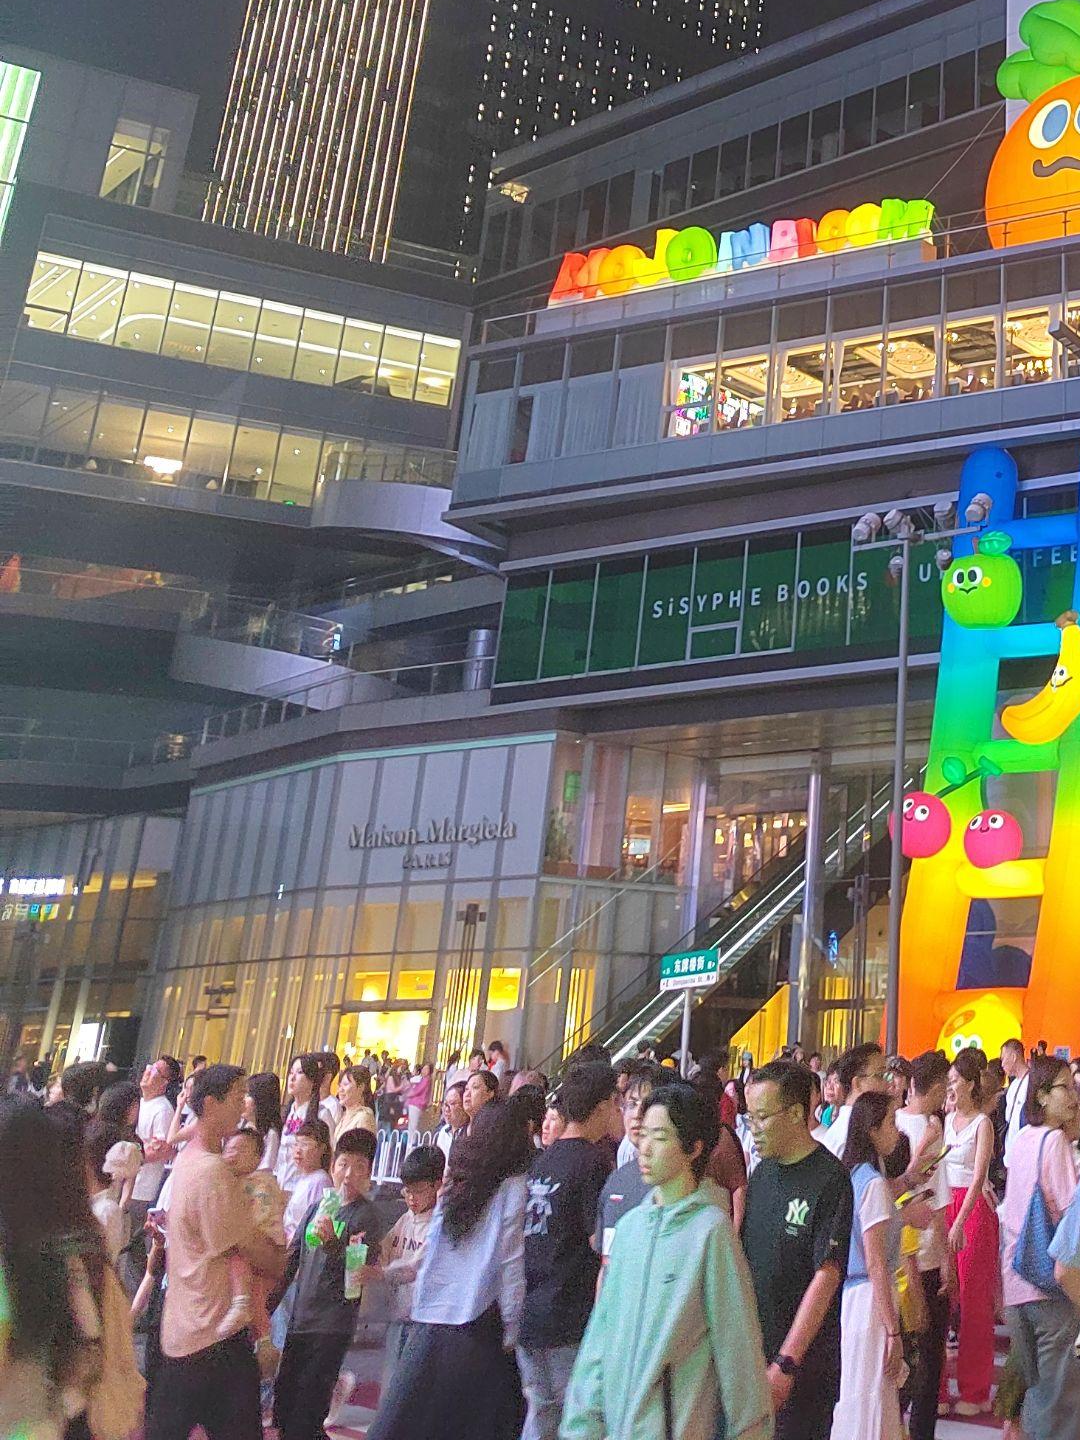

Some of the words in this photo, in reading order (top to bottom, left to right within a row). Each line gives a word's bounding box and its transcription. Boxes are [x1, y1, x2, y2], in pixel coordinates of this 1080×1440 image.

[777, 572, 868, 603] BOOKS
[349, 823, 419, 849] Maison
[426, 815, 517, 849] Margiela
